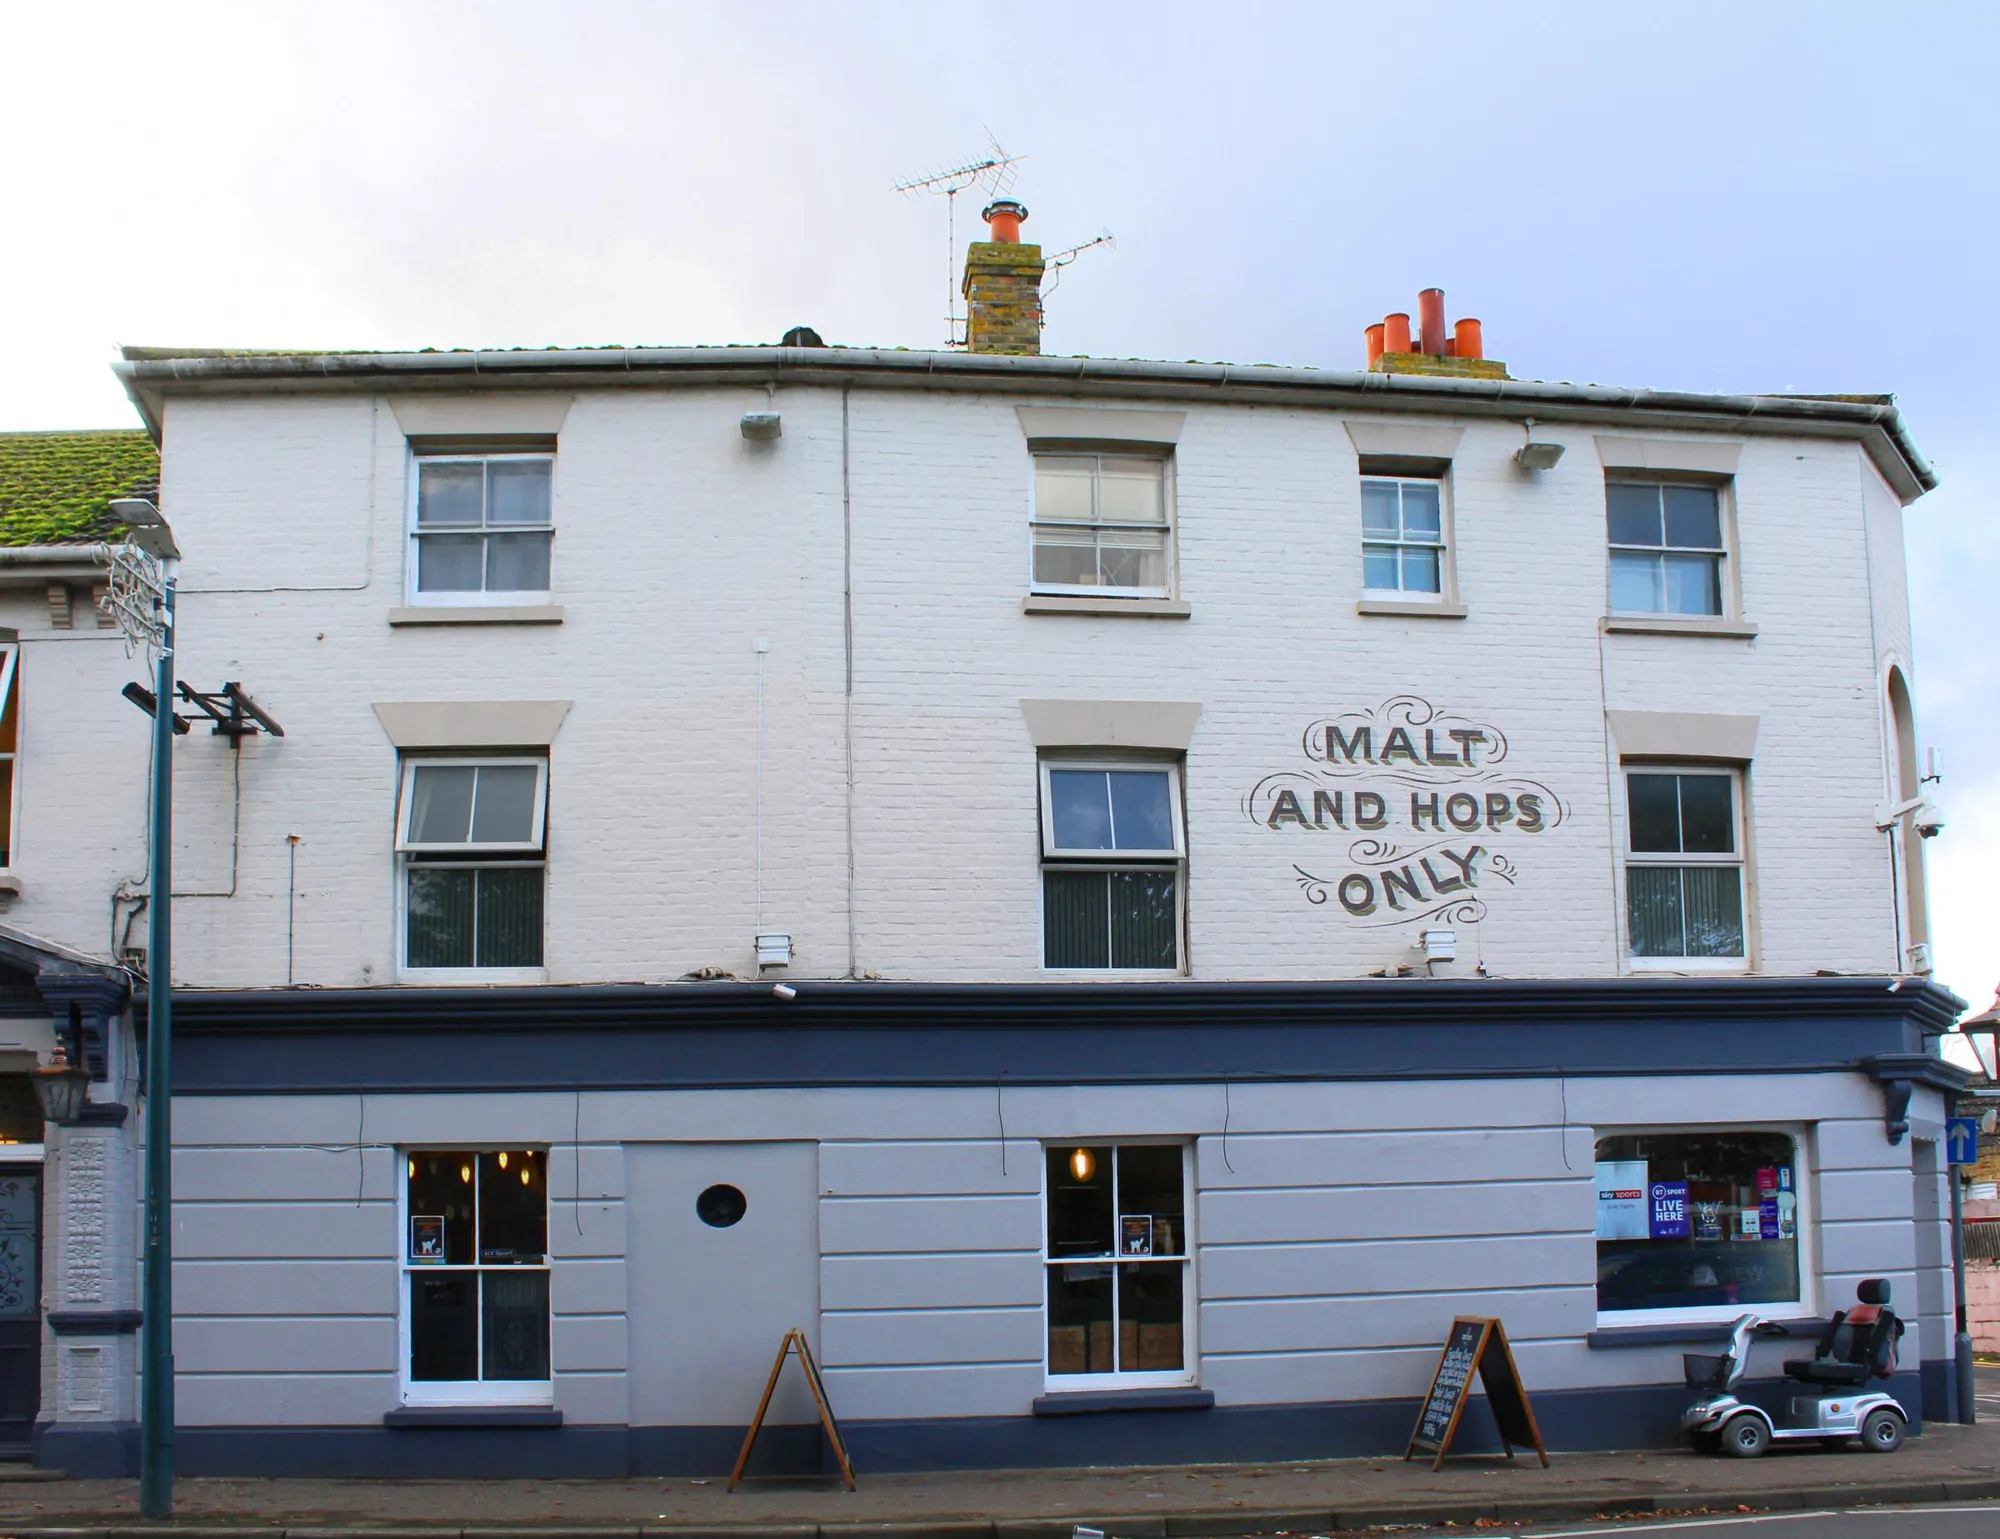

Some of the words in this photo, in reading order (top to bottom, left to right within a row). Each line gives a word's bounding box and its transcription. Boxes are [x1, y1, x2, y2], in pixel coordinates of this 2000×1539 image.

[1325, 725, 1488, 767] MALT
[1267, 790, 1387, 831] AND
[1411, 791, 1544, 833] HOPS
[1337, 845, 1488, 917] ONLY
[1601, 1191, 1614, 1199] sky
[1616, 1190, 1641, 1199] sports
[1666, 1188, 1686, 1196] SPORT
[1655, 1200, 1684, 1212] LIVE
[1655, 1211, 1684, 1222] HERE
